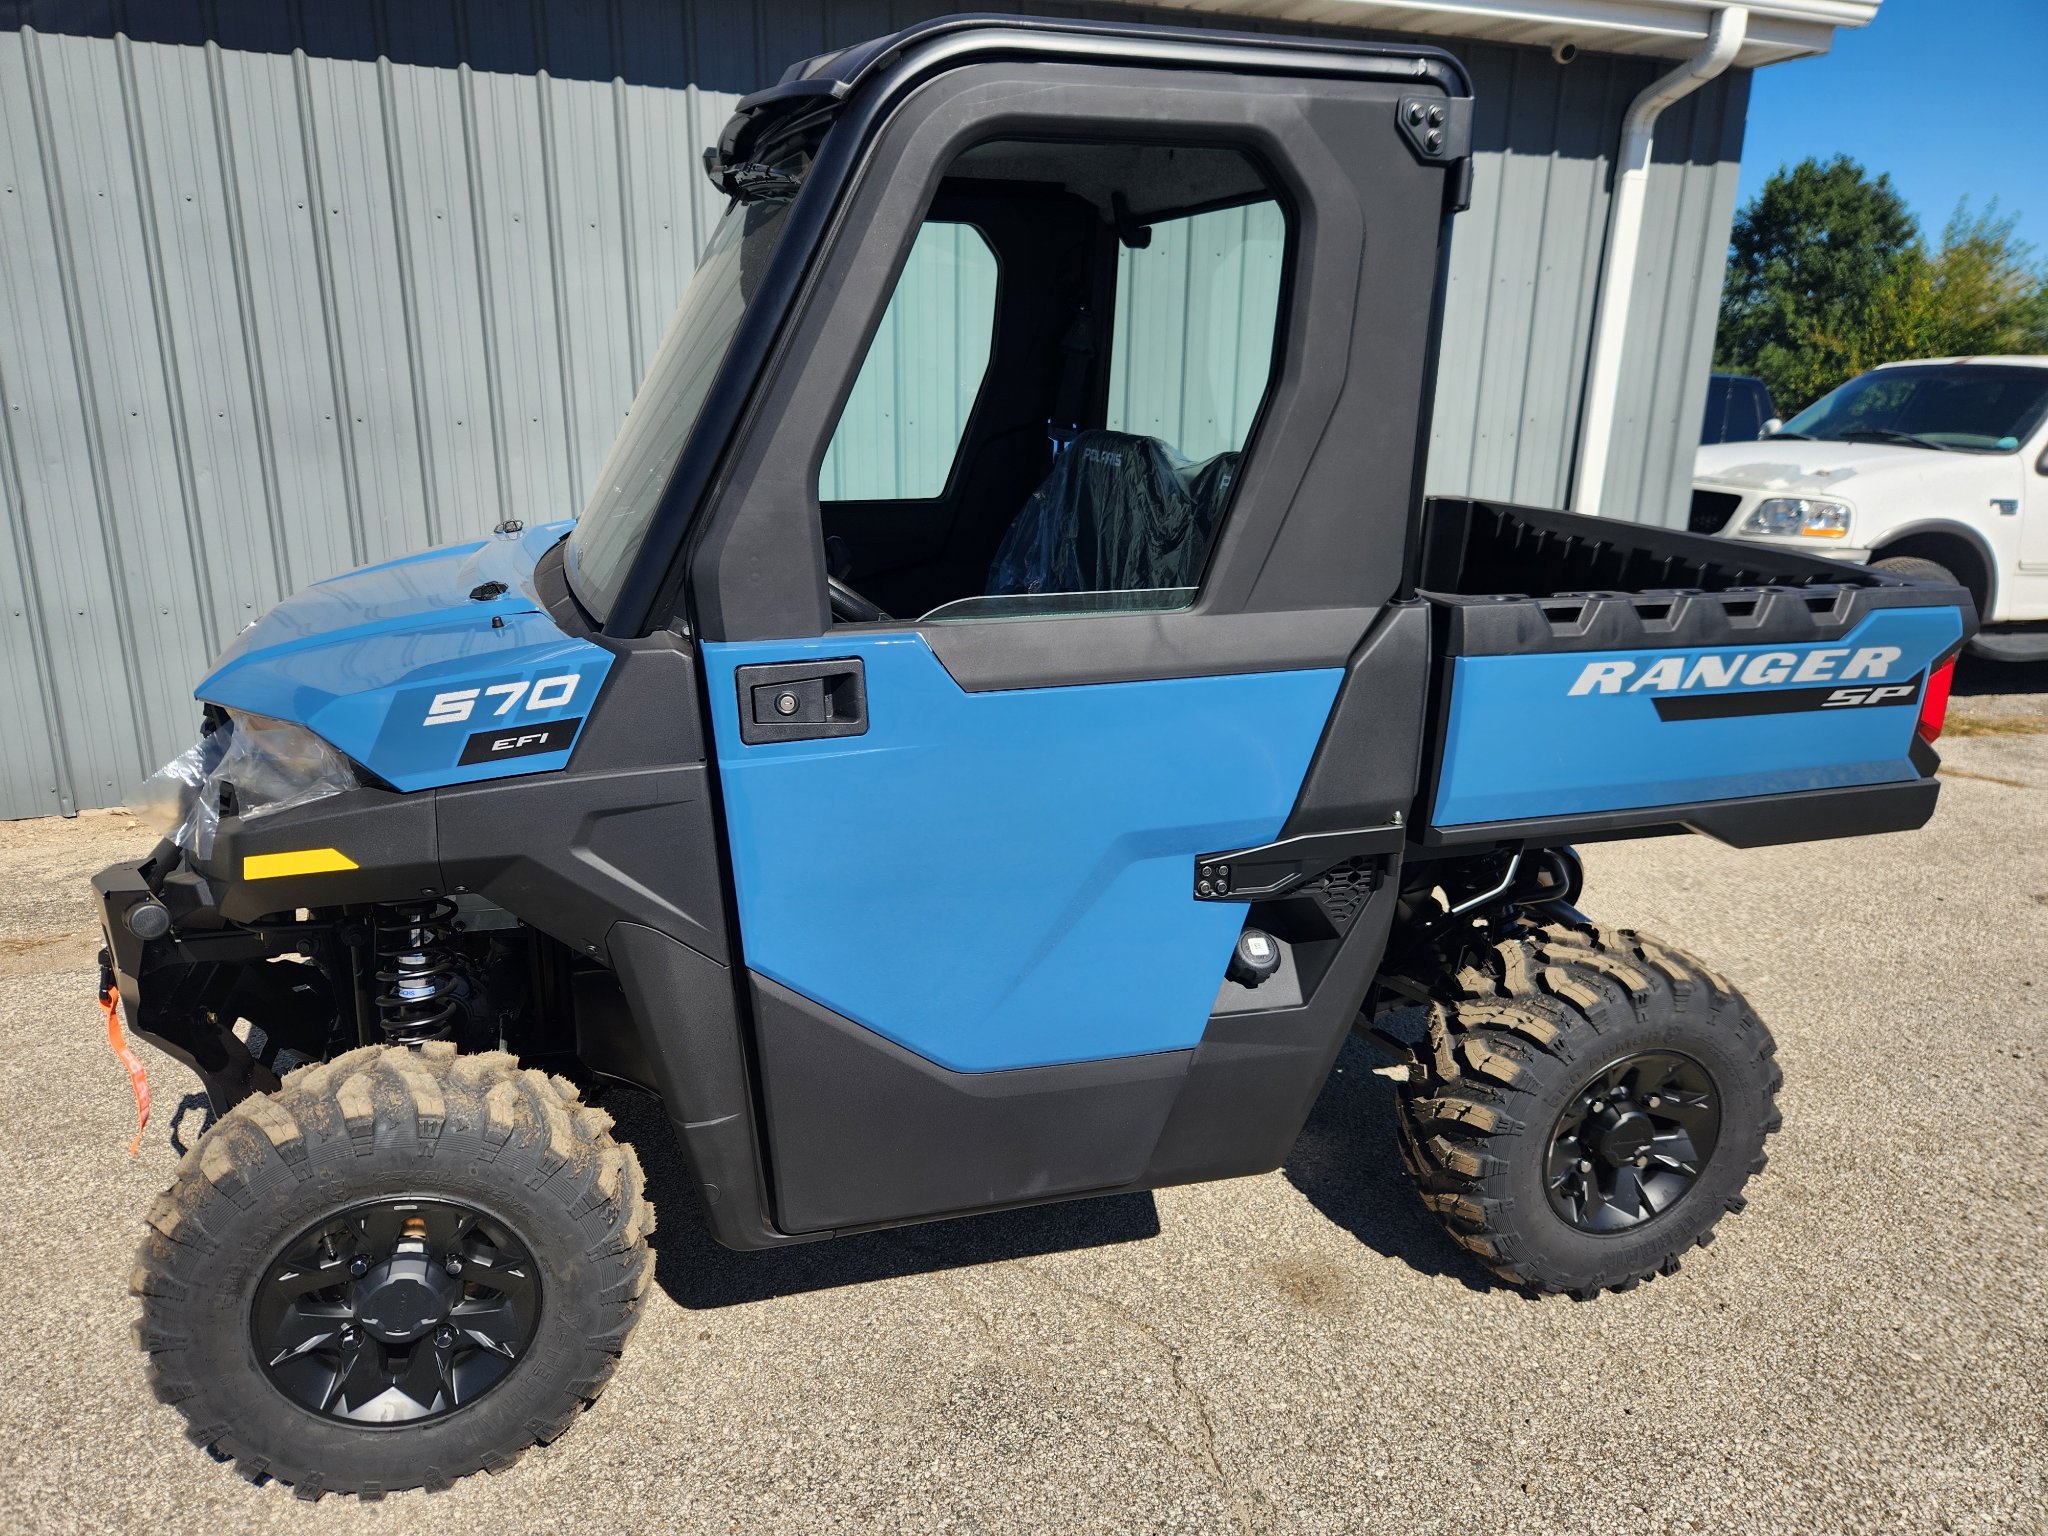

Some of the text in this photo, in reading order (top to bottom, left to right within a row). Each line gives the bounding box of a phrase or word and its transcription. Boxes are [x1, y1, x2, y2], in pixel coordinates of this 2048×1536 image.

[1083, 447, 1122, 467] POLARIS
[1567, 646, 1901, 696] RANGER
[423, 673, 580, 727] 570
[1820, 685, 1915, 707] SP
[492, 732, 549, 751] EFI
